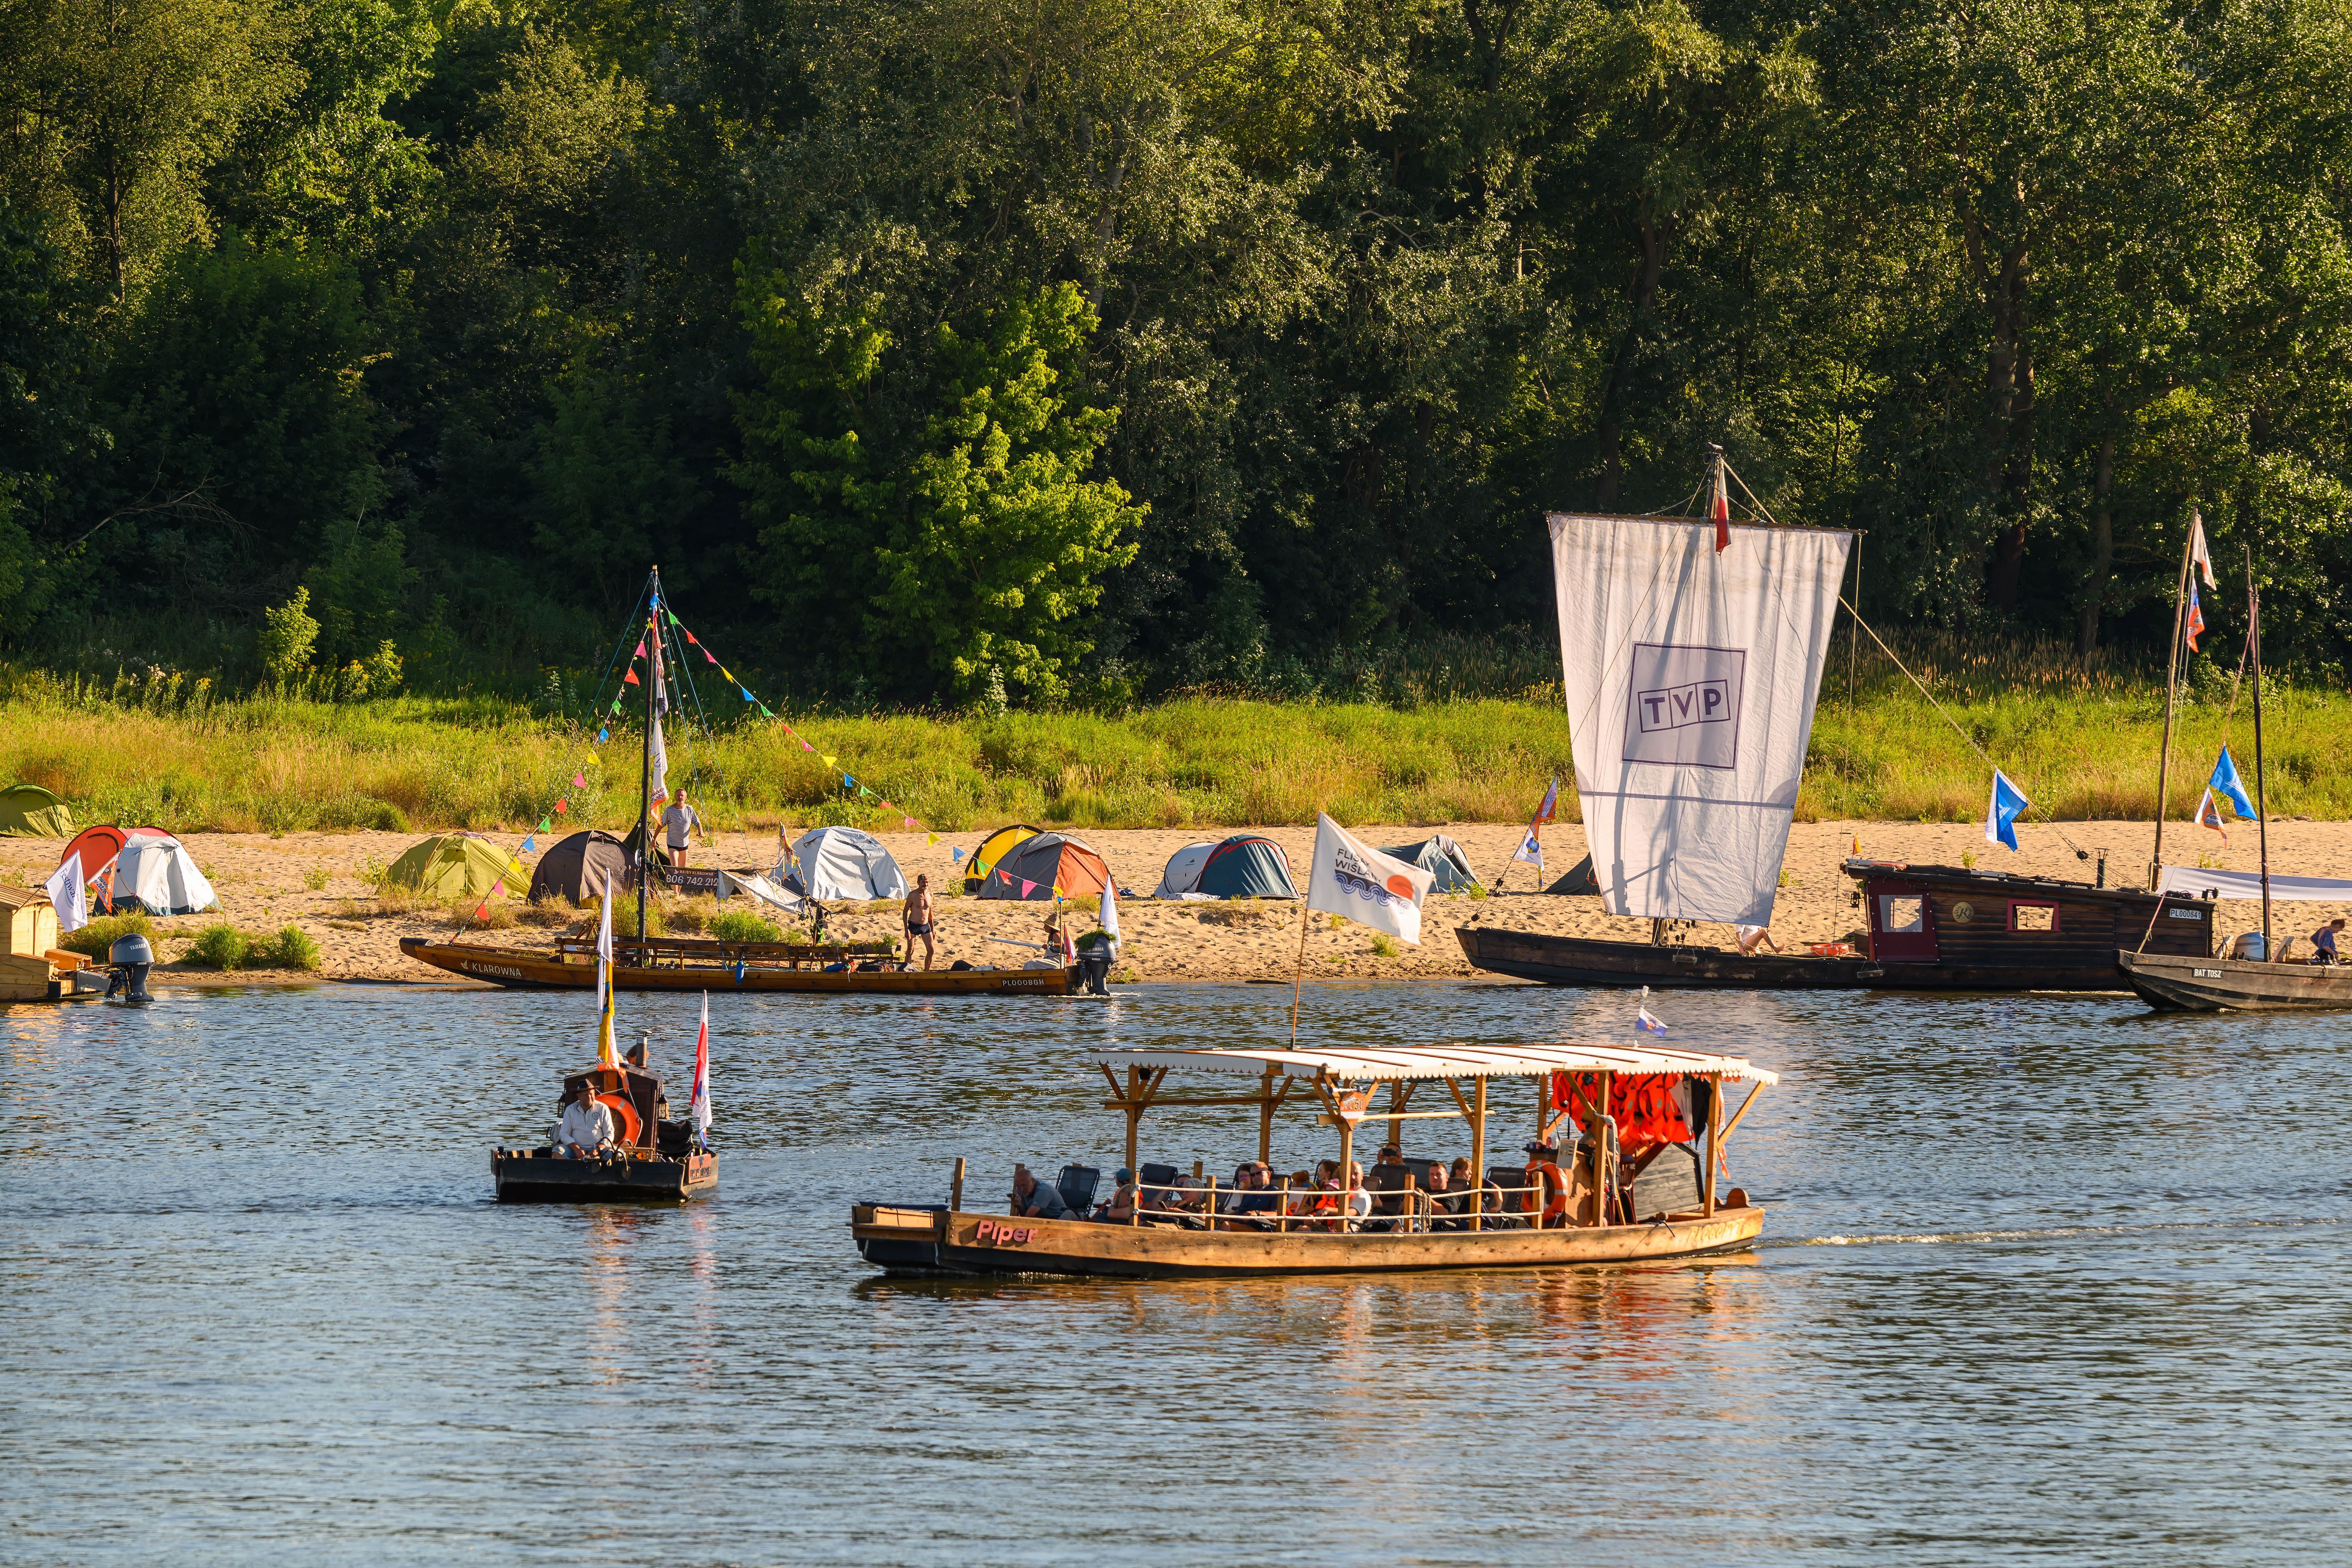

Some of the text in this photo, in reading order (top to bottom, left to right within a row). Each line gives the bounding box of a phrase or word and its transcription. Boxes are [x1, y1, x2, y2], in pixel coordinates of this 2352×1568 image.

[1644, 688, 1722, 724] TVP
[666, 874, 719, 887] 606 742 212
[472, 962, 522, 976] KLAROWNA
[976, 1220, 1039, 1245] Piper
